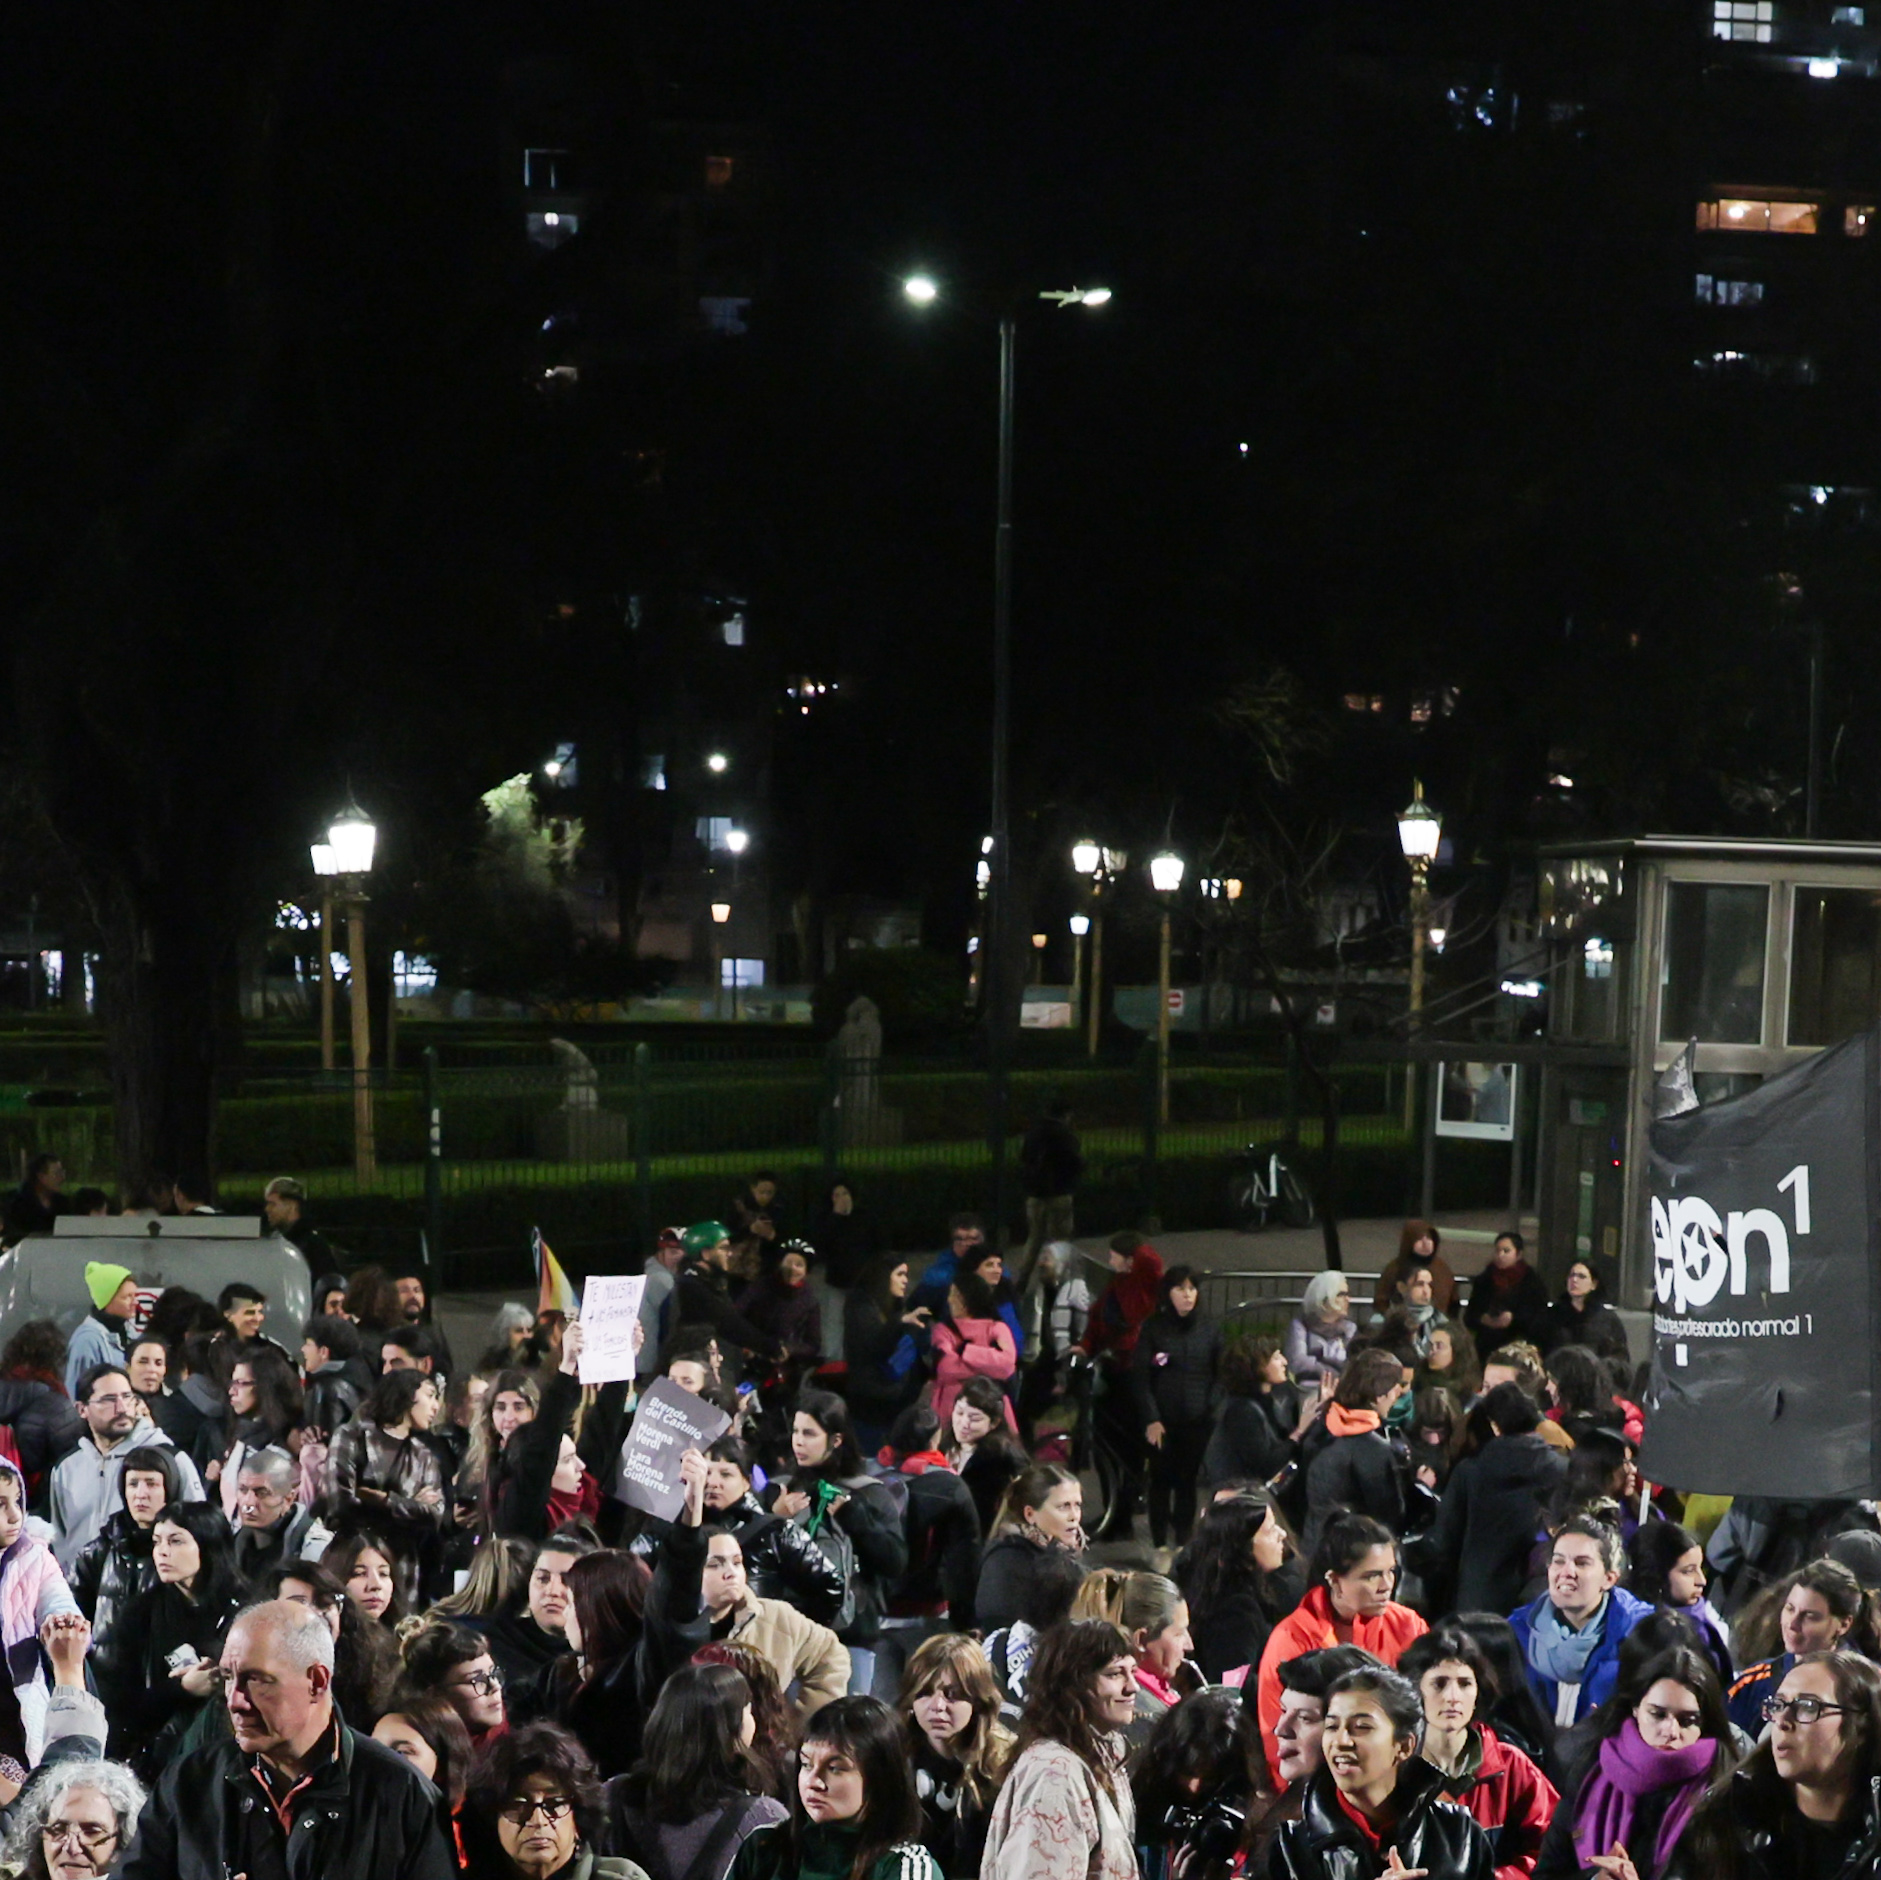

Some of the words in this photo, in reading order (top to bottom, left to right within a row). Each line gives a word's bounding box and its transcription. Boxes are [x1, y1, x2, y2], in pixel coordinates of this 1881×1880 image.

[1742, 1315, 1800, 1337] normal
[1805, 1313, 1813, 1335] 1
[649, 1396, 688, 1422] Brenda
[638, 1422, 674, 1445] Morena
[645, 1406, 663, 1420] del
[663, 1413, 702, 1440] Castillo
[636, 1430, 662, 1450] Verdi
[630, 1448, 652, 1465] Lara
[623, 1467, 670, 1494] Gutiérrez
[626, 1457, 664, 1481] Morena
